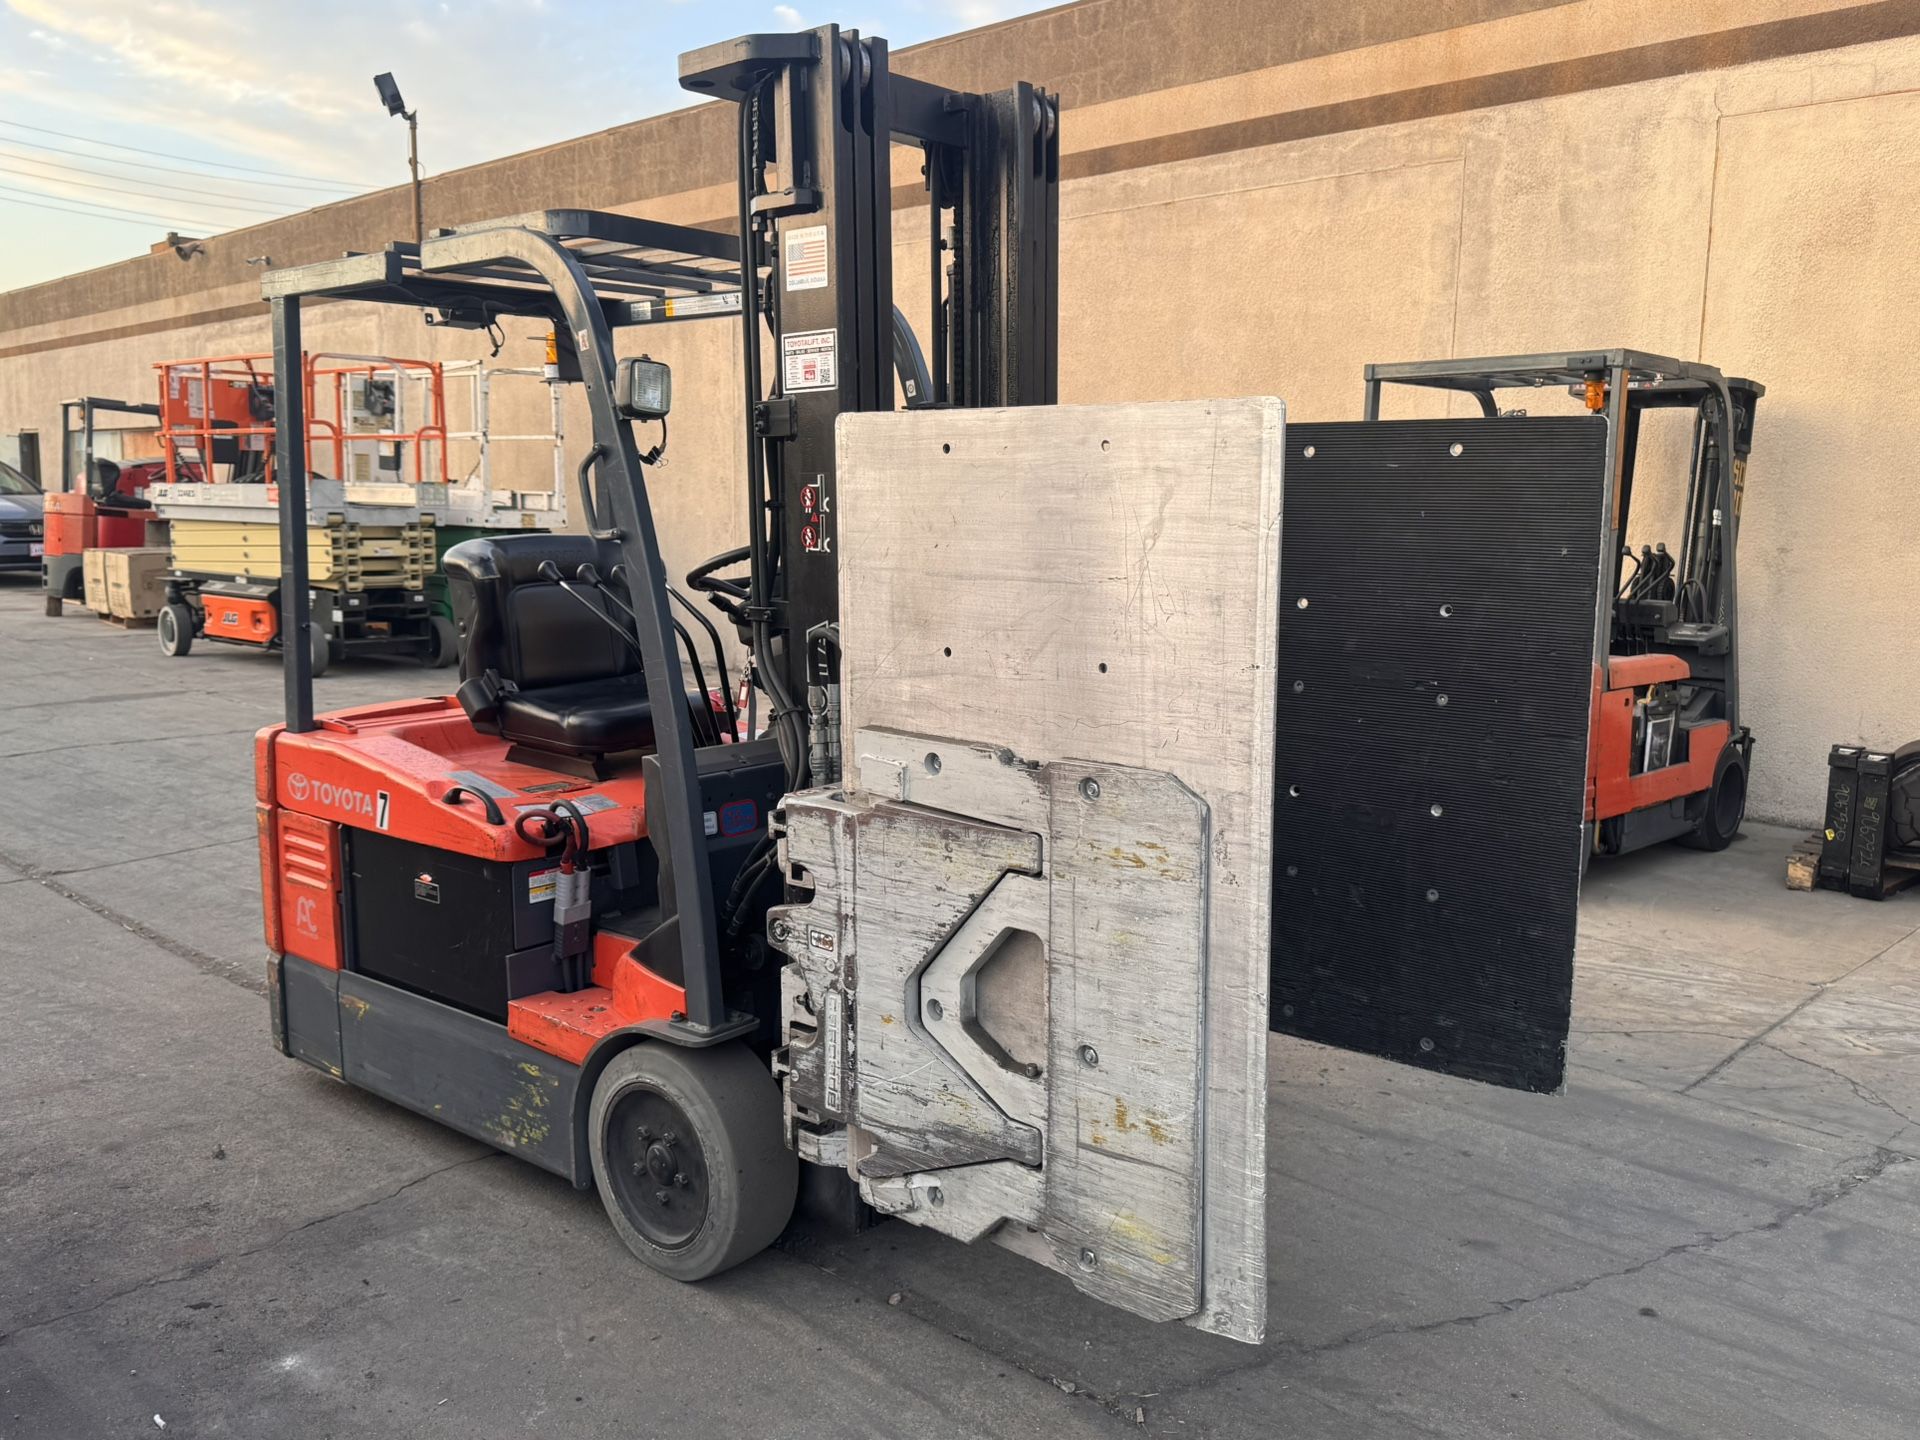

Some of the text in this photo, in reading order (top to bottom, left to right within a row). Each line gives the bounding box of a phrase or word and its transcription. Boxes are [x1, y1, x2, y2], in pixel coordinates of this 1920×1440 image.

[223, 611, 239, 624] JLG
[311, 780, 374, 817] TOYOTA
[378, 791, 389, 828] 7
